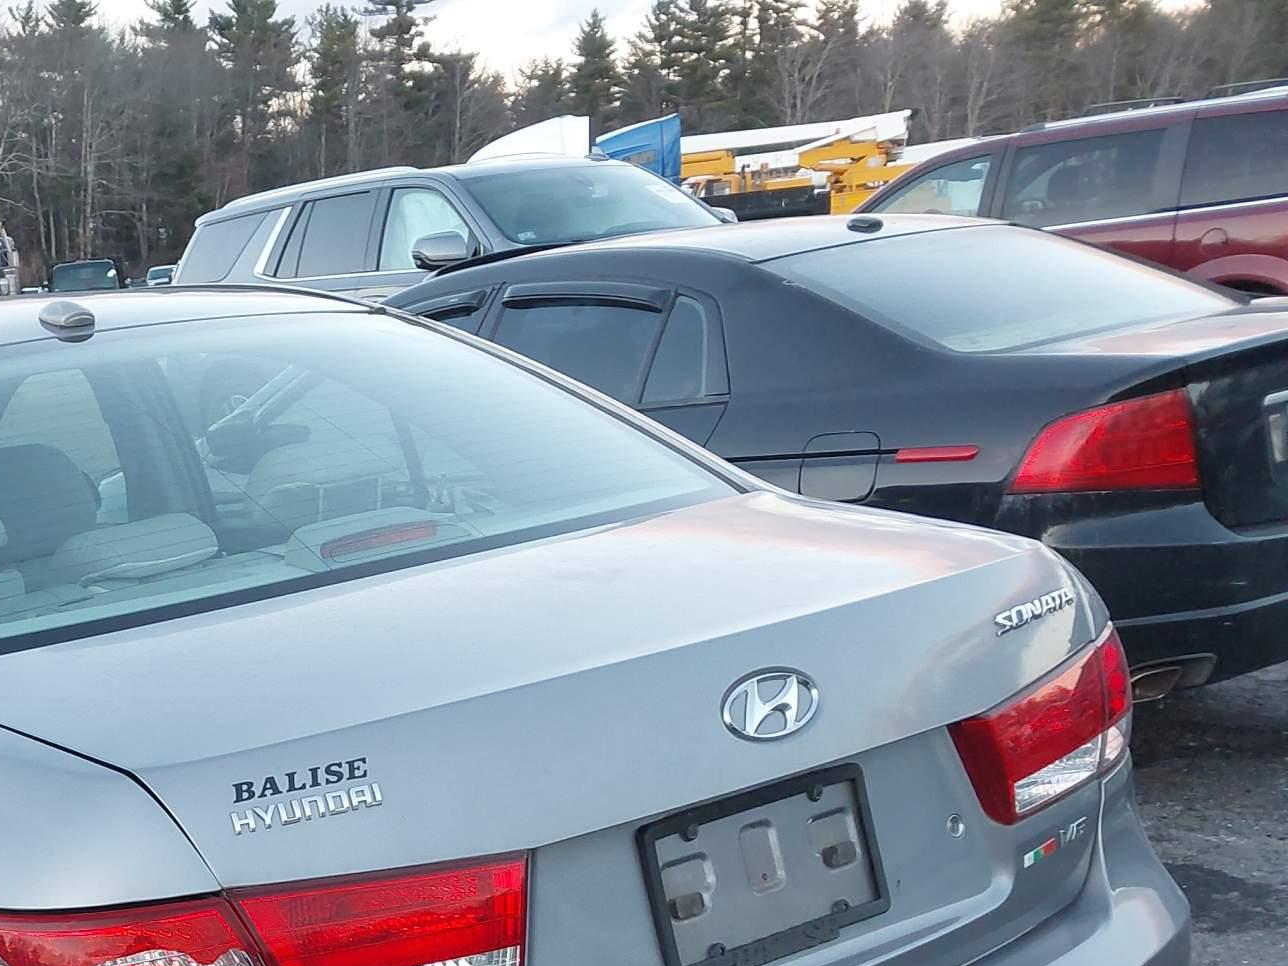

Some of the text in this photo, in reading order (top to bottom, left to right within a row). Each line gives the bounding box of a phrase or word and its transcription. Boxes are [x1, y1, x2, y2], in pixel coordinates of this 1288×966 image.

[994, 587, 1074, 637] SONATA
[232, 757, 368, 804] BALISE
[230, 783, 383, 835] HYUNDAI
